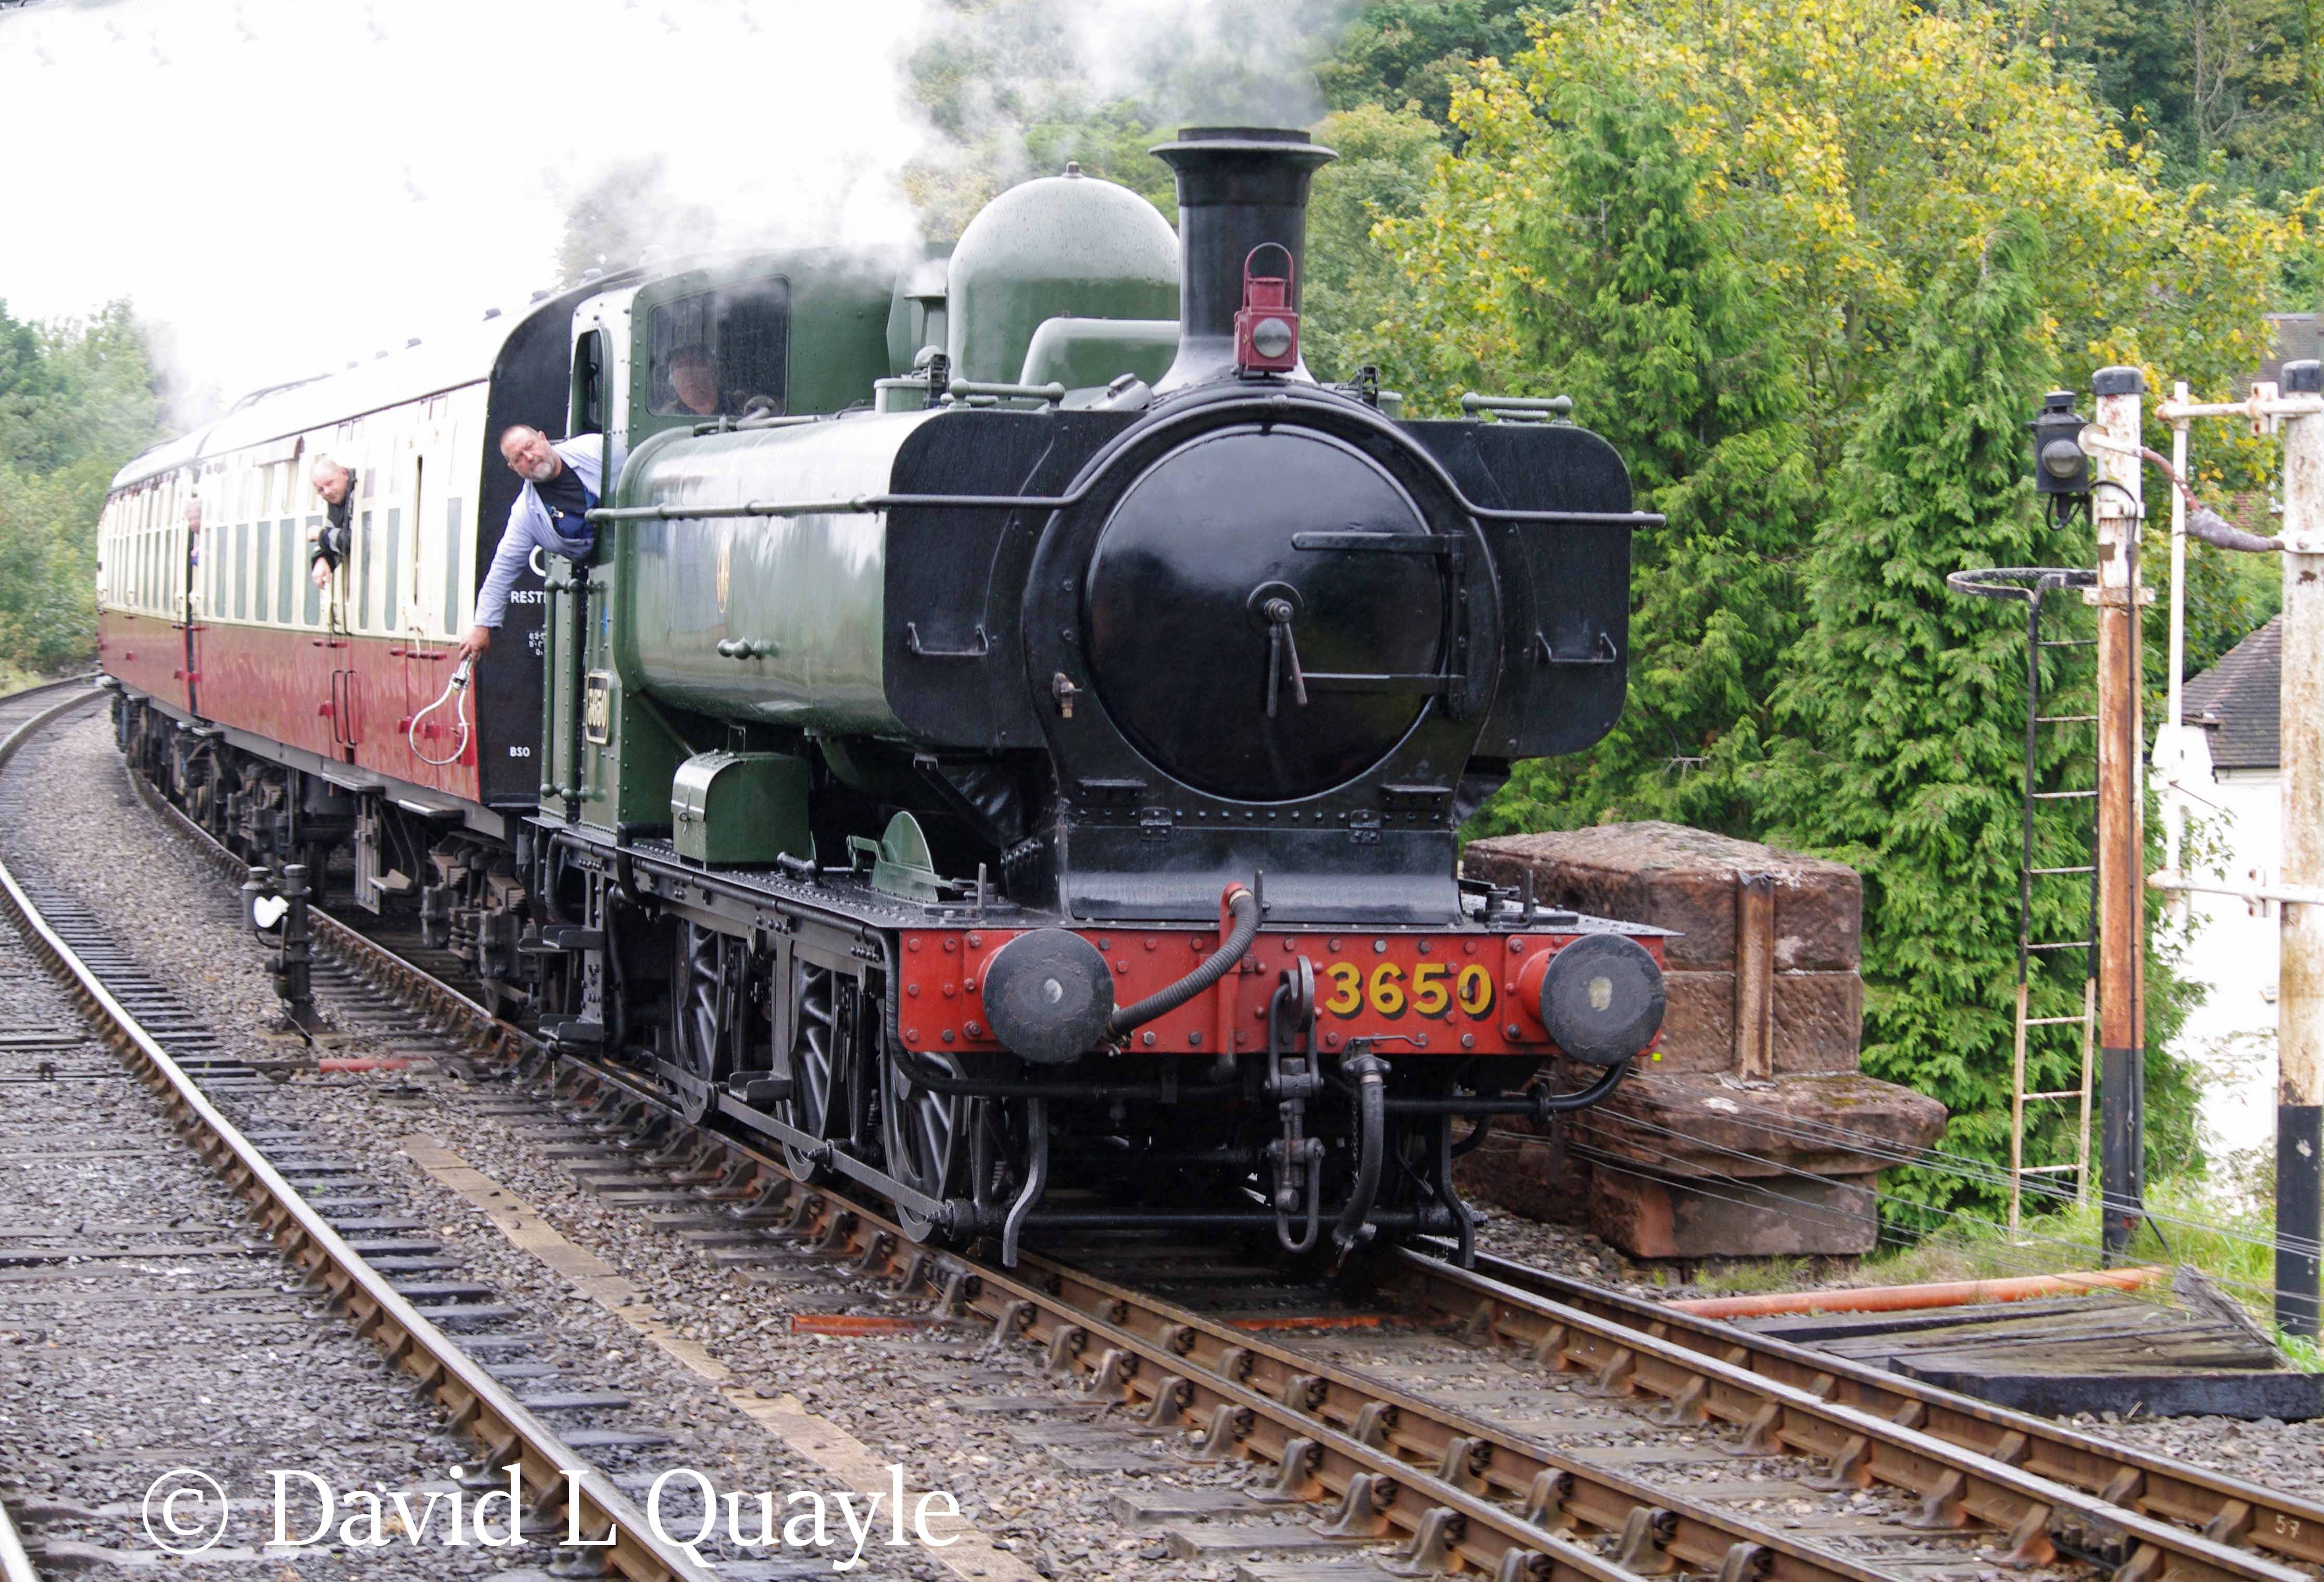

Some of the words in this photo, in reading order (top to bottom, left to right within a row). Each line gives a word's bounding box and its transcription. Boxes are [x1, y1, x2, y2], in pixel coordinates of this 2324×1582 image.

[588, 688, 607, 728] 3650
[510, 746, 530, 757] BSO
[1325, 962, 1494, 1018] 3650
